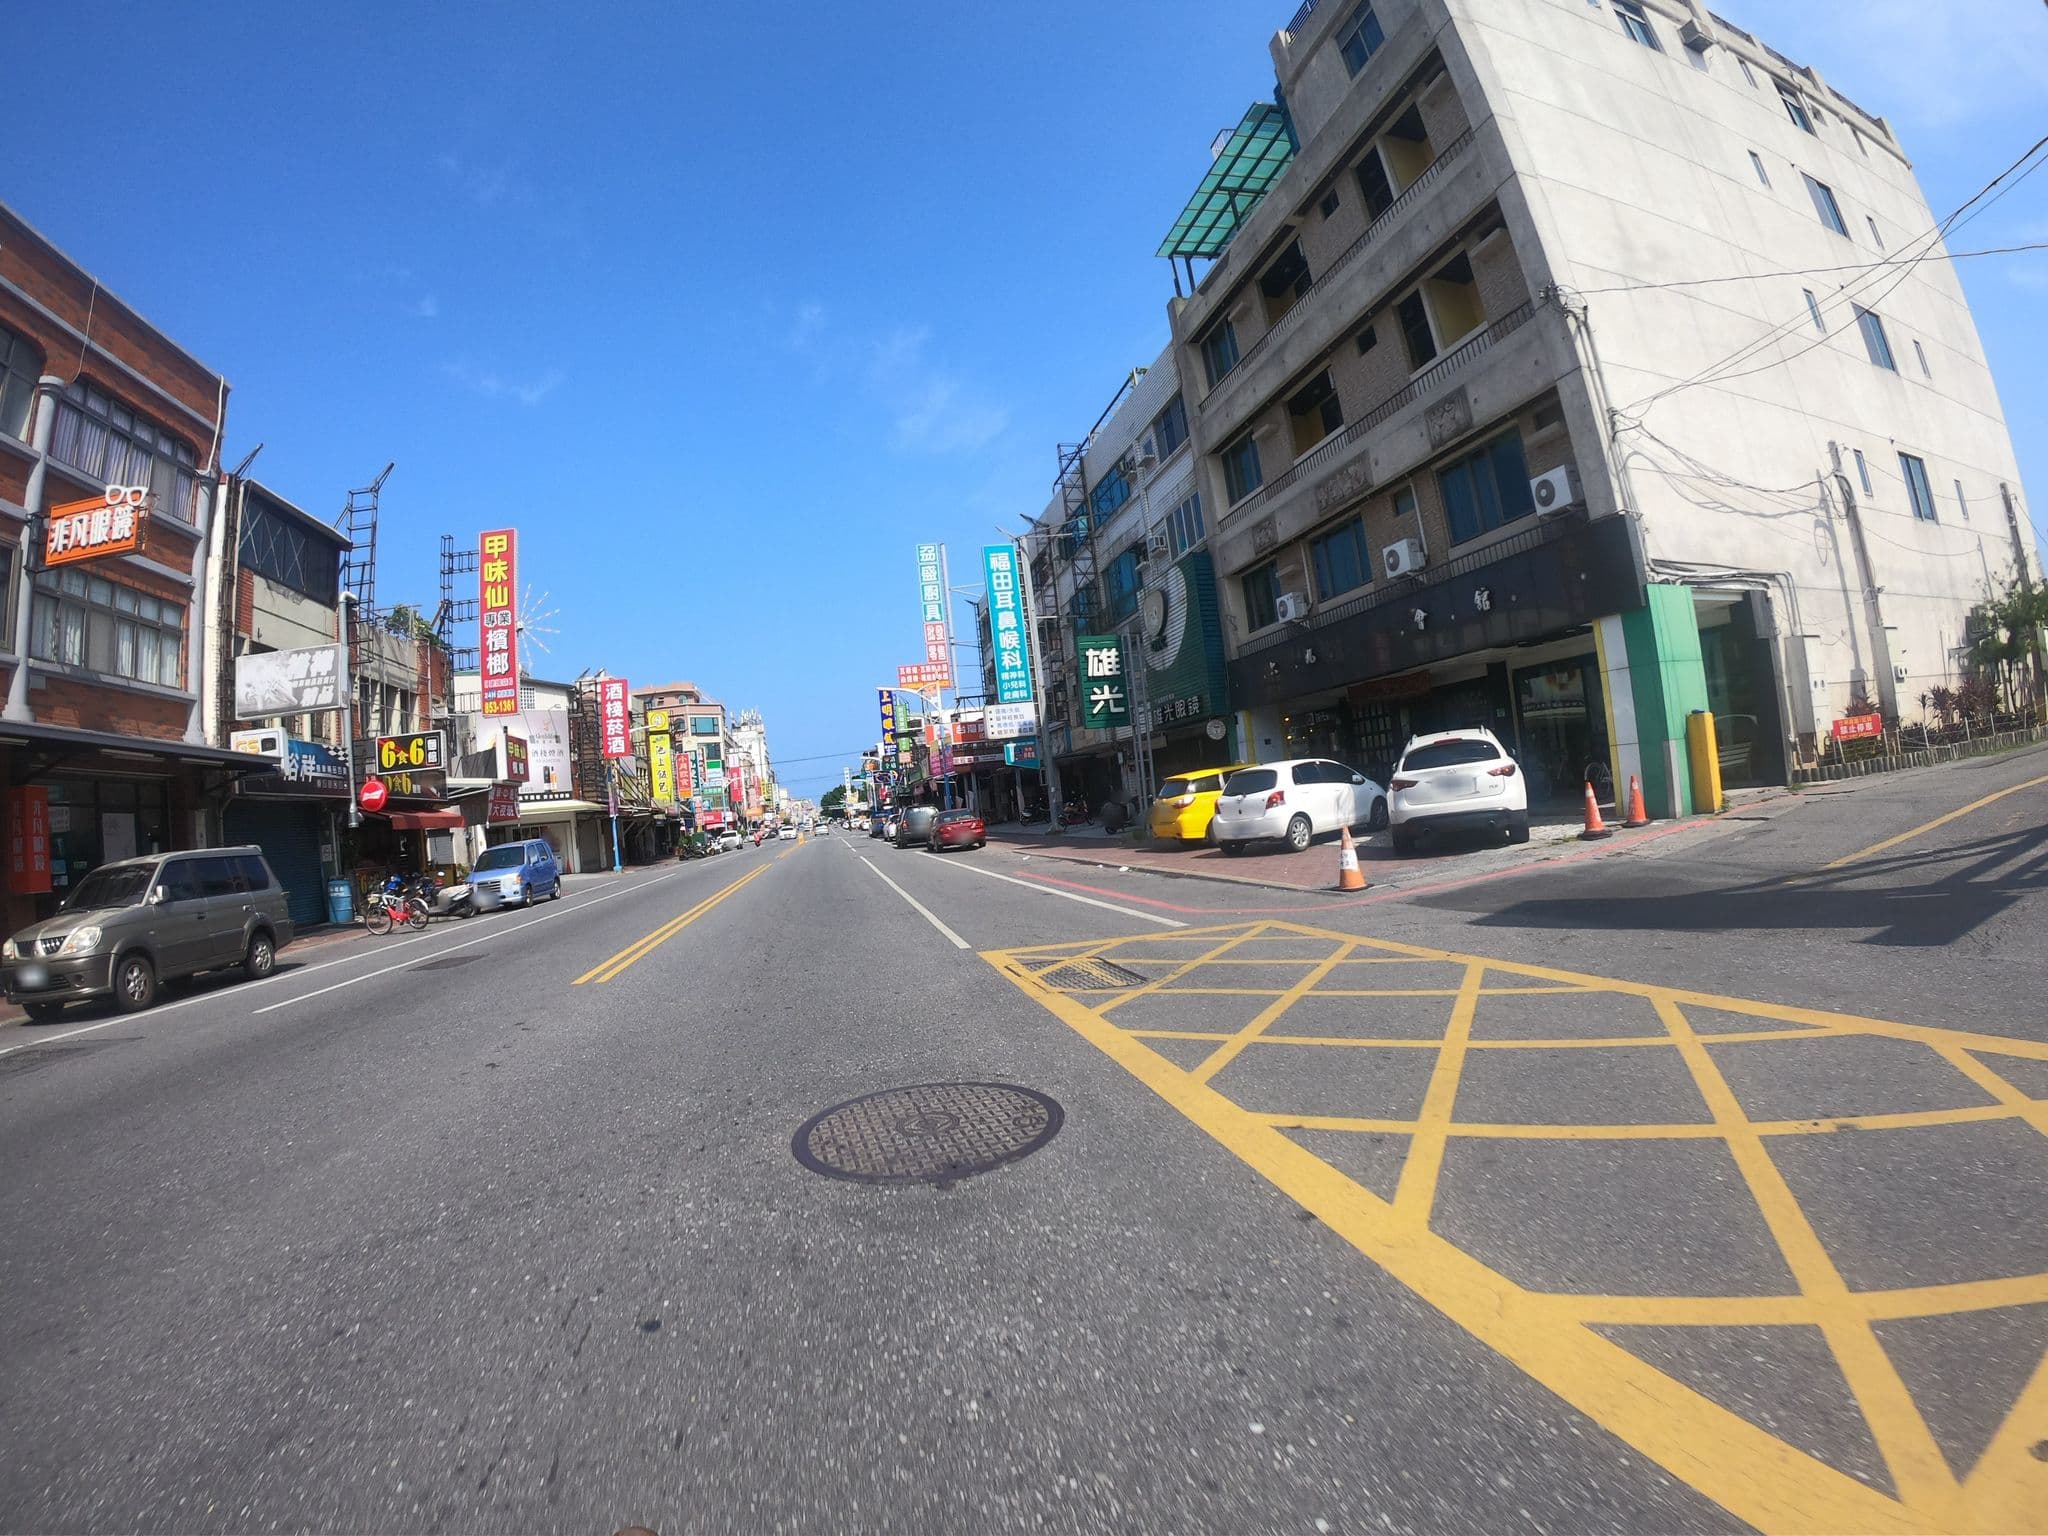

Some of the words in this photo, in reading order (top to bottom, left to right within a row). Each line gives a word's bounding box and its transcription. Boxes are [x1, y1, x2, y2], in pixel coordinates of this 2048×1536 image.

[48, 505, 134, 553] 非凡眼鏡
[484, 534, 509, 609] 甲味仙
[483, 610, 511, 628] 專業
[989, 552, 1022, 670] 福田耳鼻喉科
[486, 629, 509, 676] 檳榔
[1002, 671, 1025, 681] 精神科
[1003, 681, 1026, 690] 小兒科
[1003, 690, 1028, 700] 皮膚科
[1086, 648, 1125, 714] 雄光
[605, 682, 625, 754] 酒棧菸酒
[283, 752, 317, 783] 裕祥
